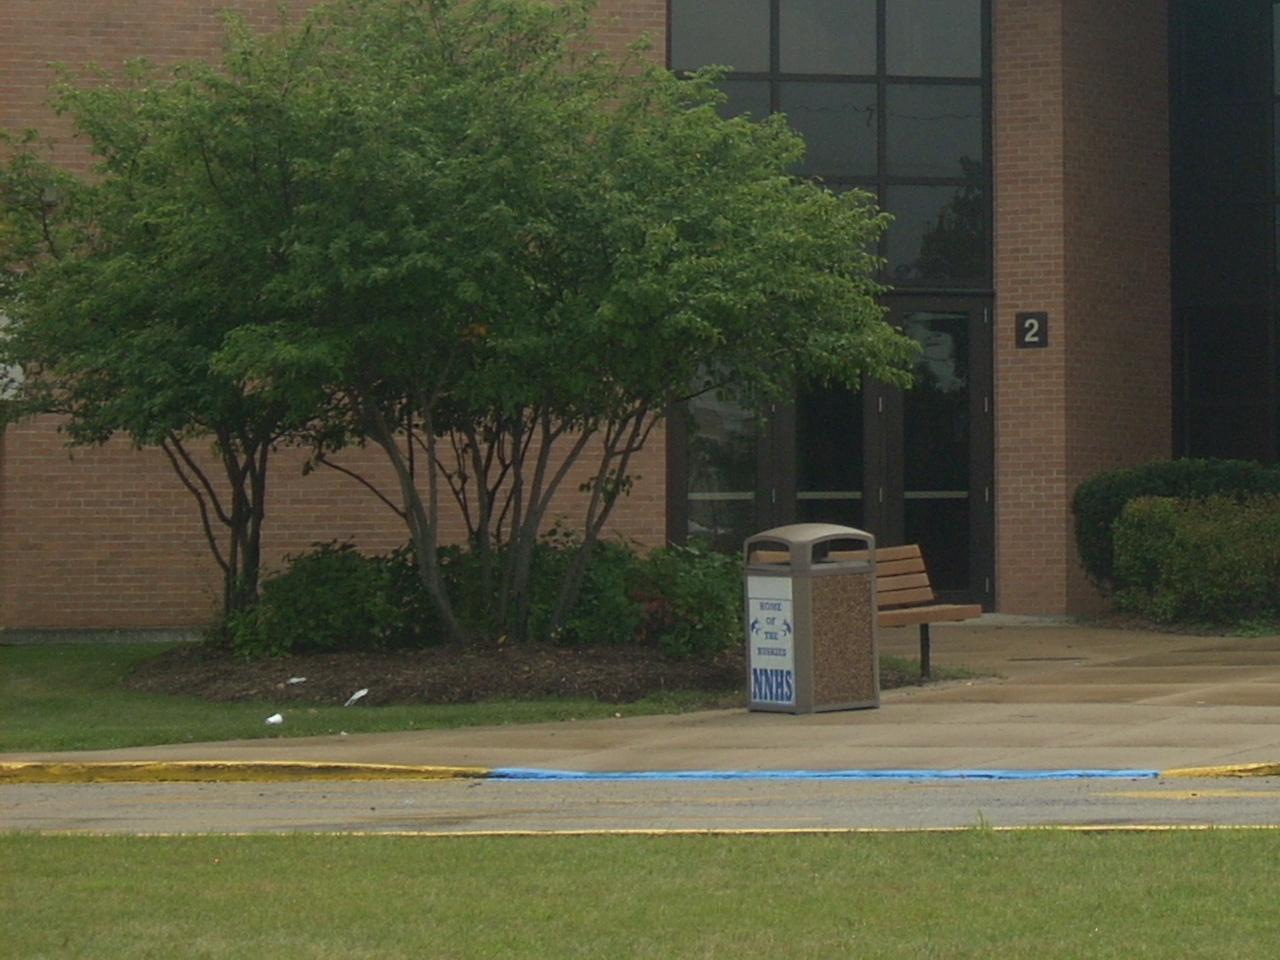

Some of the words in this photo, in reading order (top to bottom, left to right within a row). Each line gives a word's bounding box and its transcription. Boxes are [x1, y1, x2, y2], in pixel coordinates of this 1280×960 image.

[1024, 319, 1039, 342] 2
[760, 602, 782, 611] HOME
[766, 617, 776, 625] OF
[764, 631, 778, 640] THE
[753, 668, 792, 701] NNHS
